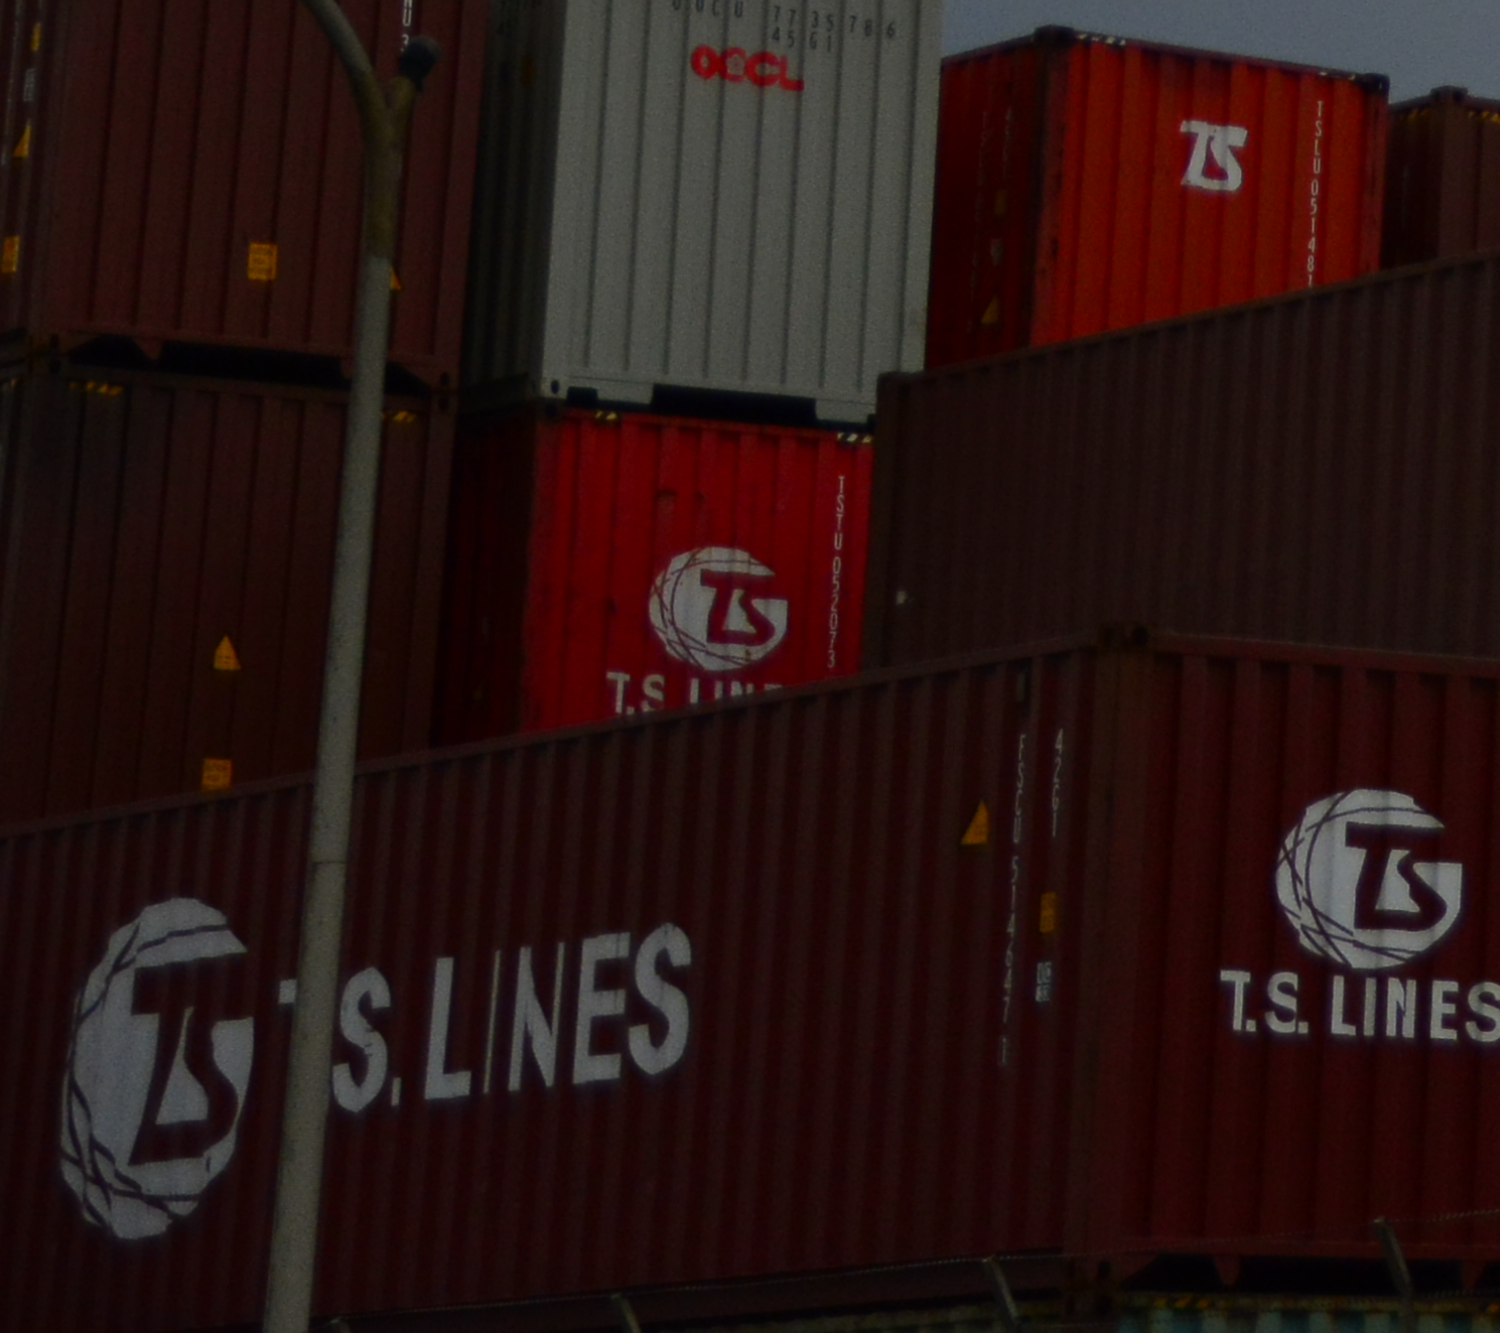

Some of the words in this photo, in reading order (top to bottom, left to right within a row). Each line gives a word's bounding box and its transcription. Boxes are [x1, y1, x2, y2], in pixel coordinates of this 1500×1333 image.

[1312, 100, 1325, 175] TSLU
[834, 475, 846, 550] TSTU
[424, 922, 692, 1100] LINES
[1220, 970, 1309, 1034] T.S.
